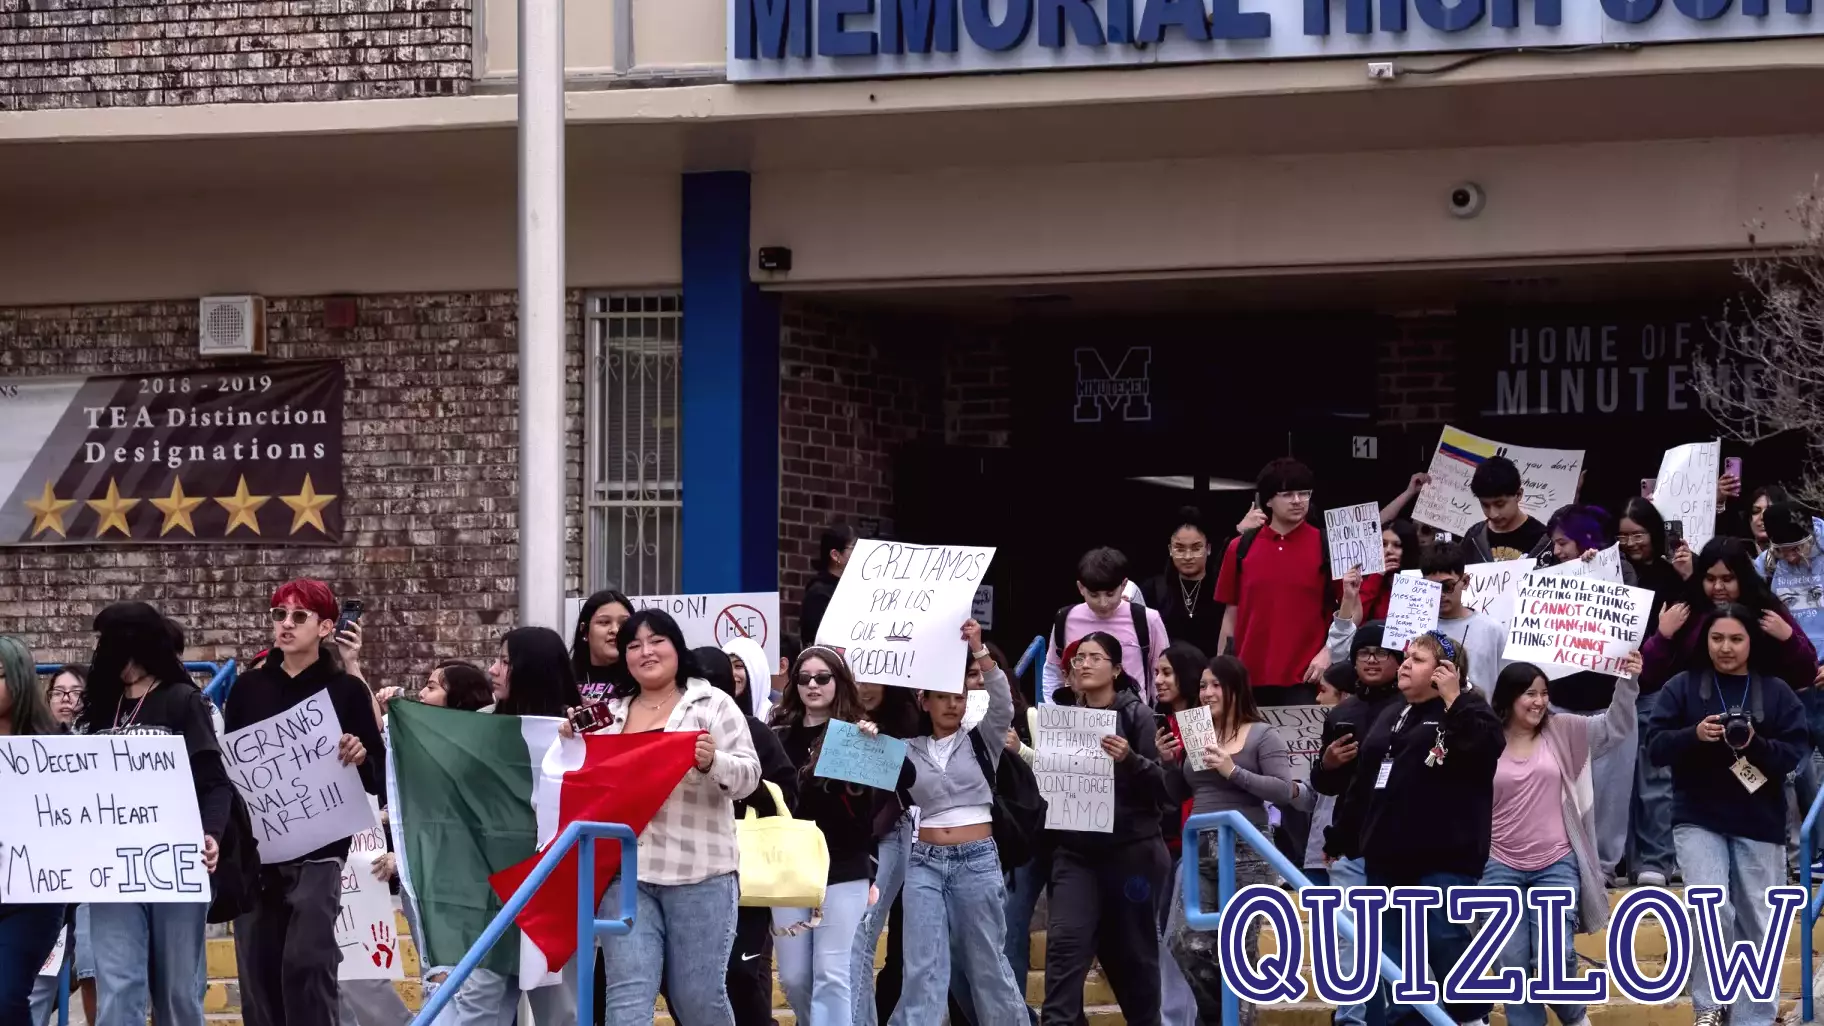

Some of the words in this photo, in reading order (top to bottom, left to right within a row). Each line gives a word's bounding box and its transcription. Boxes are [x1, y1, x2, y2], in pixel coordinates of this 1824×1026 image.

[1509, 325, 1617, 364] HOME
[138, 377, 191, 394] 2018
[218, 375, 273, 392] 2019
[83, 406, 155, 429] TEA
[166, 405, 328, 428] Distinction
[85, 438, 326, 469] Designations
[1521, 460, 1543, 475] you
[1550, 456, 1578, 472] don't
[1326, 509, 1348, 528] OUR
[861, 543, 986, 582] GRITAMOS
[1331, 540, 1368, 577] HEARD
[1519, 587, 1571, 600] ACCEPTING
[1574, 591, 1593, 602] THE
[1595, 594, 1637, 611] THINGS
[1537, 577, 1557, 589] AM
[1560, 577, 1578, 590] NO
[1580, 581, 1631, 598] LONGER
[870, 589, 901, 613] POR
[904, 589, 935, 612] LOS
[1520, 599, 1526, 614] I
[1530, 600, 1584, 617] CANNOT
[1585, 606, 1640, 626] CHANGE
[850, 620, 880, 641] QUE
[887, 621, 914, 640] NO
[1513, 616, 1518, 628] I
[1521, 617, 1541, 630] AM
[1544, 618, 1606, 636] CHANGING
[1609, 625, 1639, 642] THE
[1511, 631, 1555, 647] THINGS
[1555, 633, 1561, 644] I
[1562, 634, 1611, 655] CANNOT
[850, 647, 916, 679] PUEDEN!
[1040, 706, 1078, 728] DON'T
[1082, 710, 1117, 728] FORGET
[1183, 707, 1205, 722] FIGHT
[1038, 730, 1064, 748] THE
[1064, 731, 1098, 749] HANDS
[1297, 726, 1322, 740] IS
[32, 739, 98, 774] DECENT
[110, 739, 176, 772] HUMAN
[1033, 749, 1072, 773] BUILT
[1082, 757, 1113, 776] CITY
[230, 752, 287, 794] NOT
[1035, 773, 1073, 793] DON'T
[1078, 776, 1115, 795] FORGET
[35, 793, 72, 828] HAS
[80, 806, 92, 824] A
[96, 793, 158, 825] HEART
[1048, 796, 1110, 829] LAMO
[7, 844, 73, 895] MADE
[89, 867, 114, 888] OF
[116, 843, 203, 893] ICE
